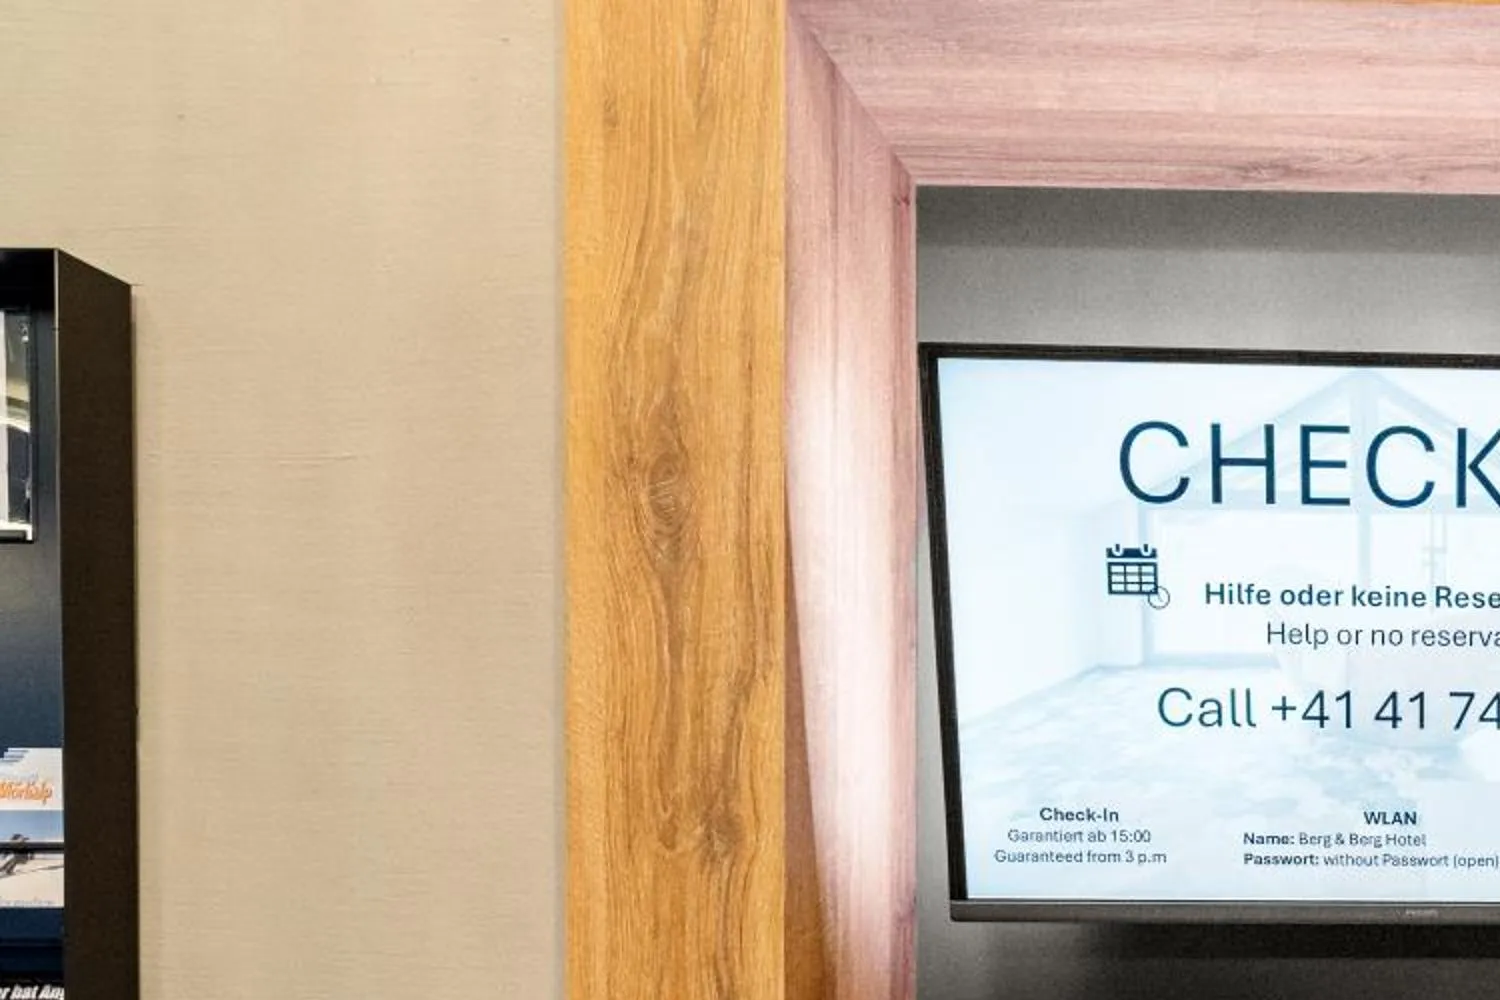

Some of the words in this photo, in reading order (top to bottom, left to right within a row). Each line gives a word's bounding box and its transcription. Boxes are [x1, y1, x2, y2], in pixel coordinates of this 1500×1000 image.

[1205, 583, 1272, 606] Hilfe
[1280, 584, 1343, 607] oder
[1352, 585, 1427, 608] keine
[1266, 622, 1329, 650] Help
[1337, 628, 1363, 646] or
[1371, 629, 1403, 647] no
[1157, 687, 1256, 729] Call
[1272, 690, 1354, 730] +41
[1375, 690, 1427, 730] 41
[1039, 806, 1120, 823] Check-In
[1363, 810, 1418, 826] WLAN
[1007, 828, 1083, 843] Garantiert
[1087, 828, 1108, 843] ab
[1112, 829, 1152, 844] 15:00
[1243, 831, 1296, 846] Name:
[1299, 832, 1332, 848] Berg
[1335, 833, 1346, 846] &
[1349, 833, 1383, 849] Berg
[1385, 833, 1427, 847] Hotel
[994, 849, 1083, 864] Guaranteed
[1087, 849, 1121, 864] from
[1125, 850, 1135, 864] 3
[1243, 852, 1320, 867] Passwort:
[1323, 853, 1380, 868] without
[1382, 853, 1449, 868] Passwort
[1453, 854, 1499, 870] (open)
